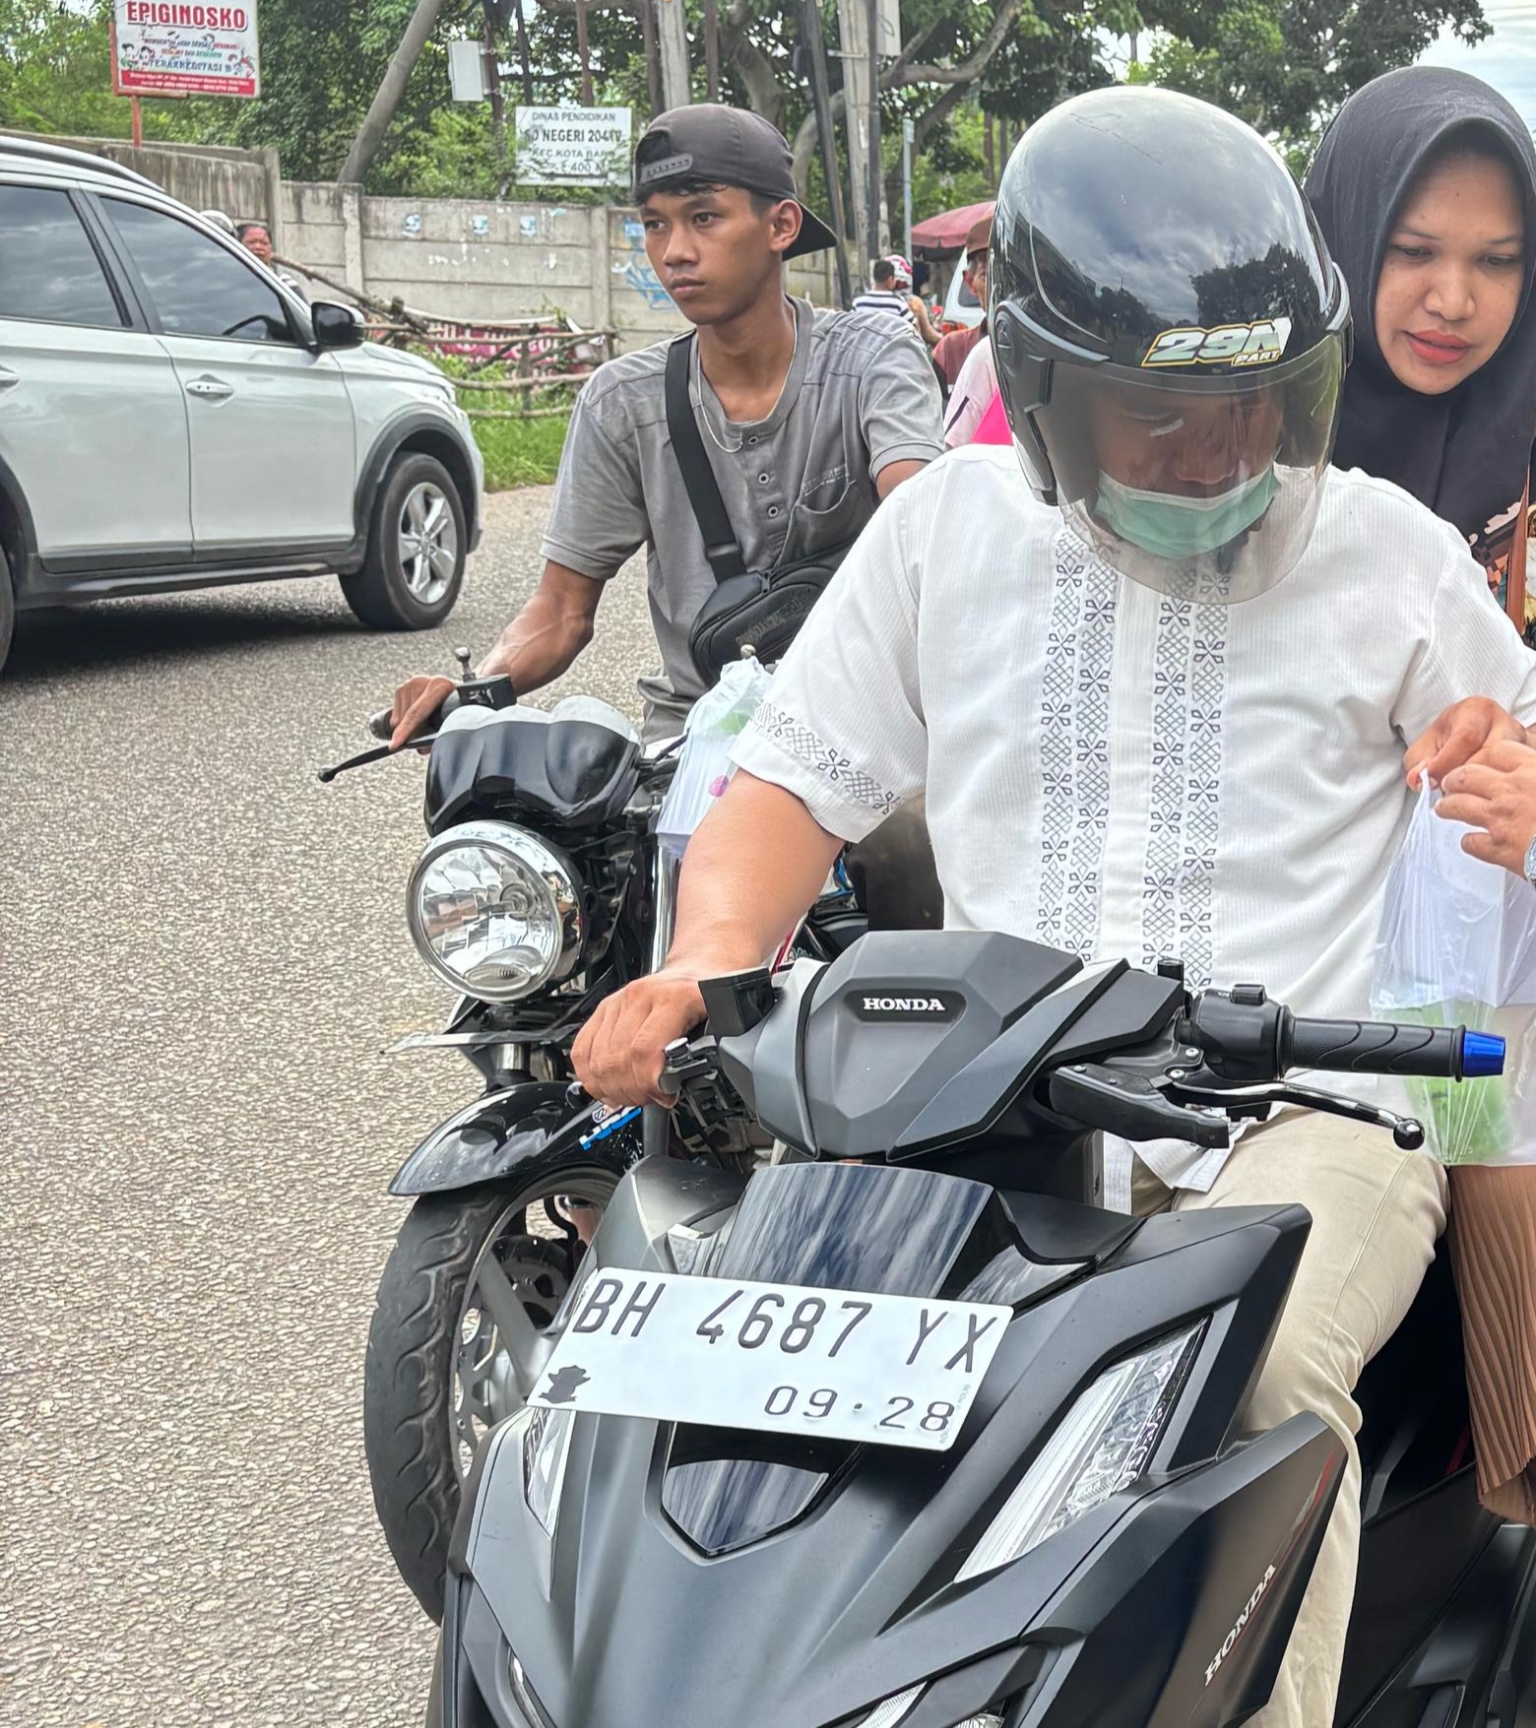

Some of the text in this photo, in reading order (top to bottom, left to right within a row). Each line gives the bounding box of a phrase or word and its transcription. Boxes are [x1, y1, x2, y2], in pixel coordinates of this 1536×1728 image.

[127, 1, 246, 29] EPIGINOSKO
[532, 112, 616, 121] DINAS PENDIDIKAN
[524, 128, 539, 141] SD
[542, 129, 585, 142] NEGERI
[1235, 352, 1279, 366] PART
[863, 998, 945, 1011] HONDA
[572, 1278, 998, 1374] BH 4687 YX
[1204, 1564, 1276, 1686] HONDA
